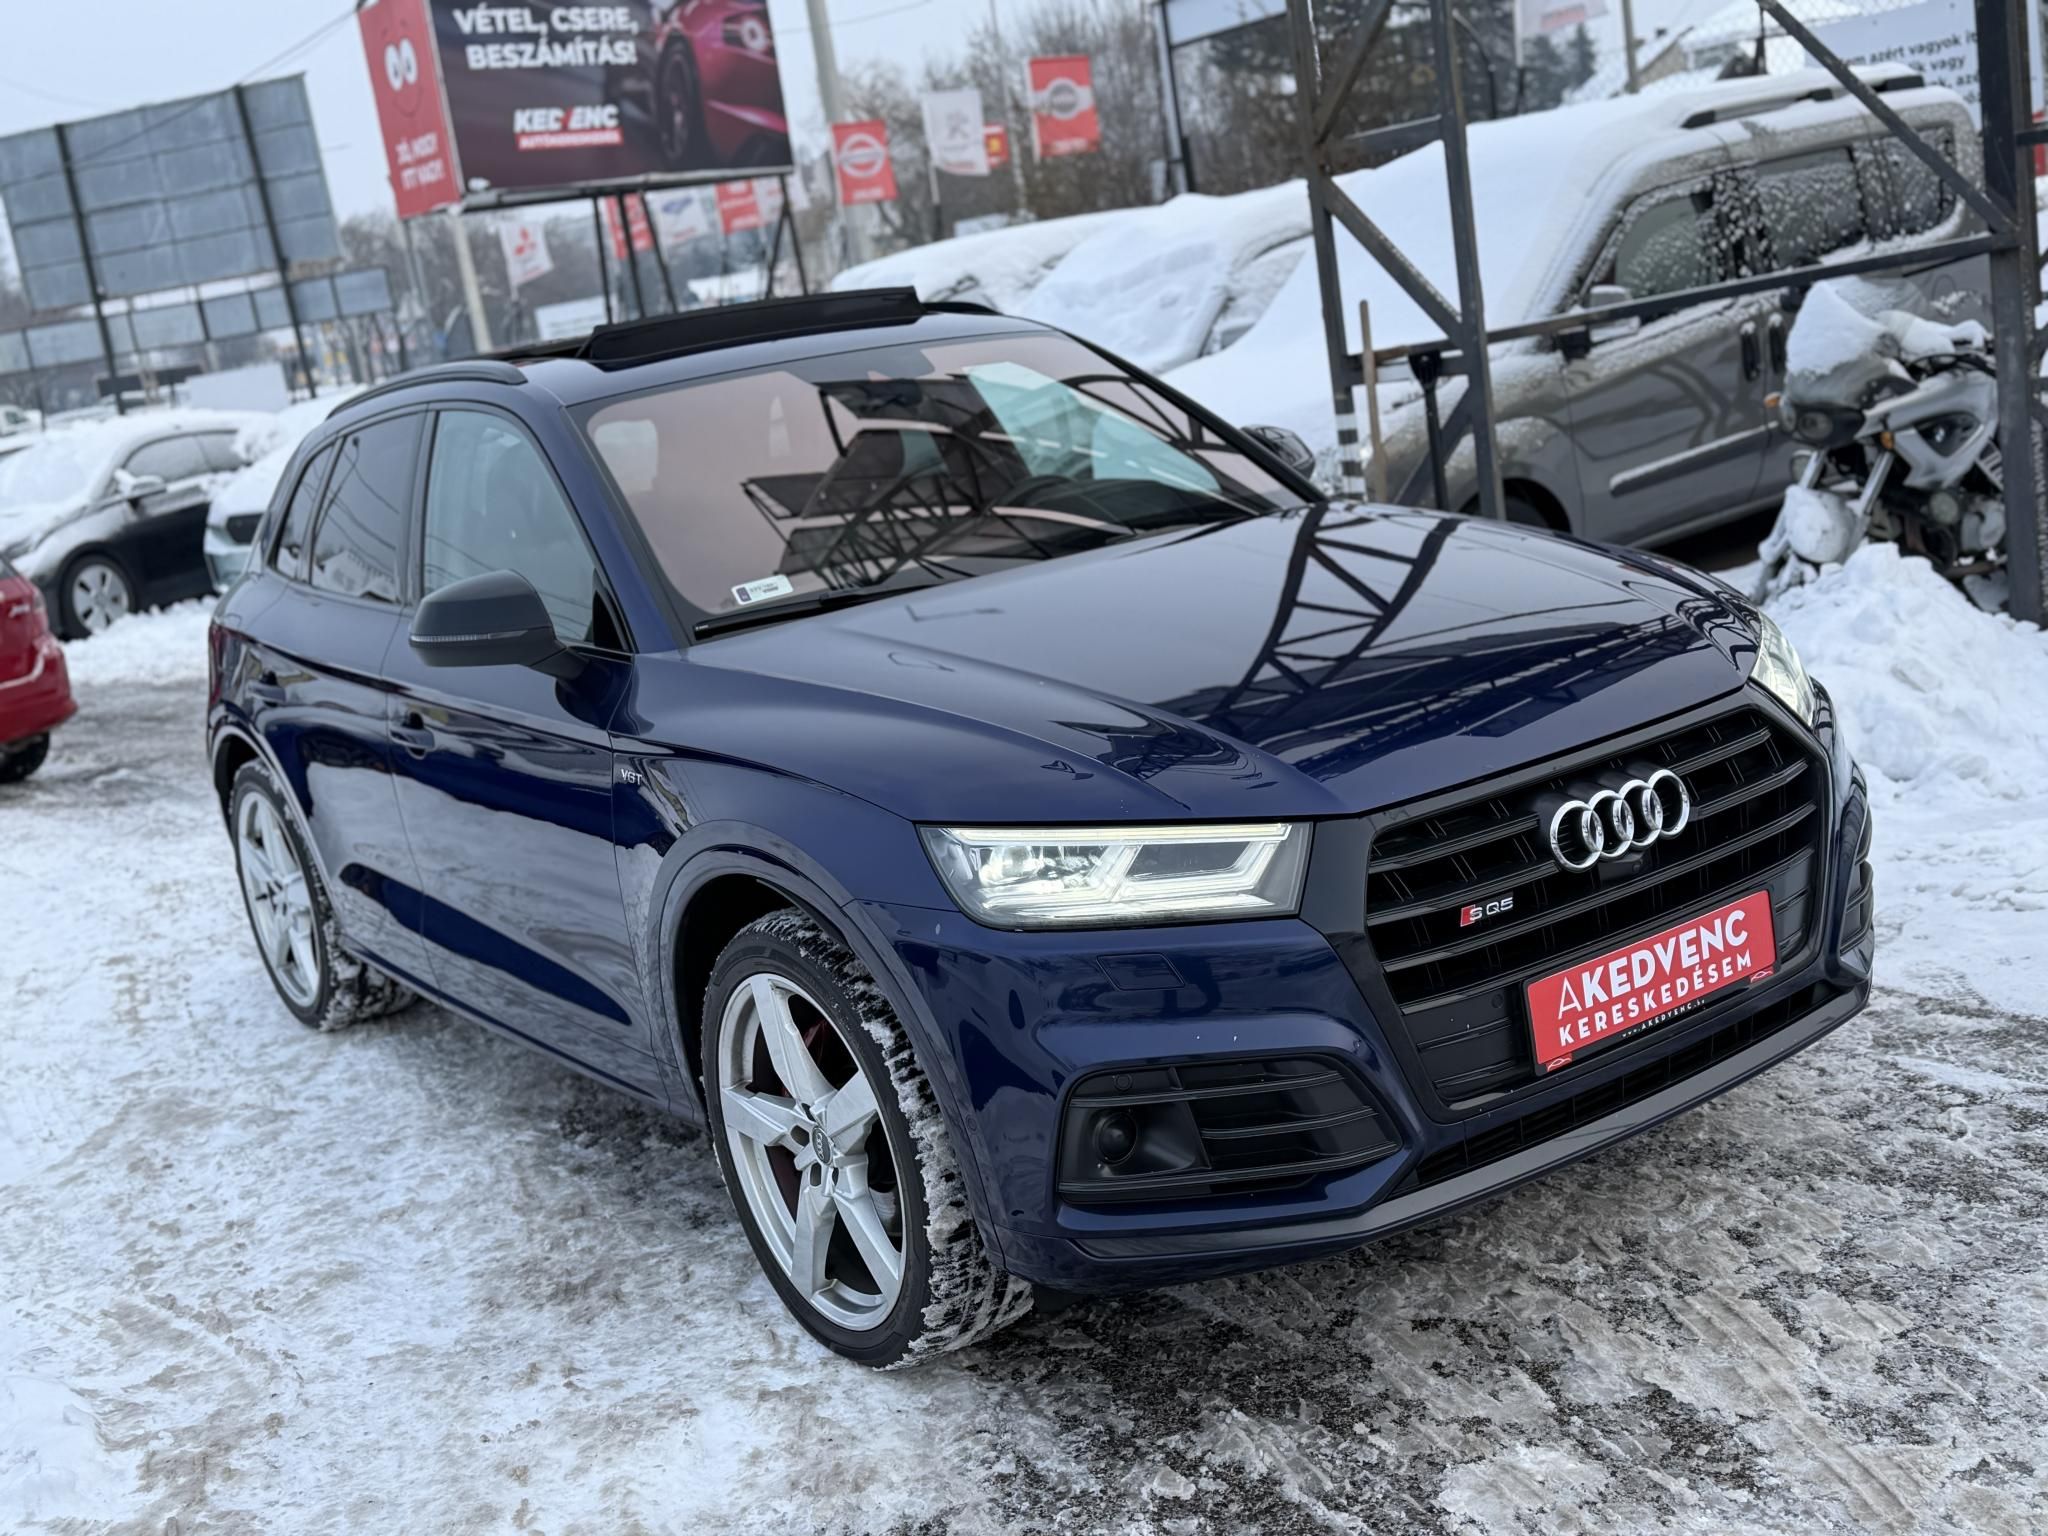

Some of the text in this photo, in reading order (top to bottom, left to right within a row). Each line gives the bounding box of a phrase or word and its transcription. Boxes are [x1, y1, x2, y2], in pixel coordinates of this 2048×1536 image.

[453, 3, 639, 36] VÉTEL, CSERE,
[465, 36, 638, 70] BESZÁMÍTÁS!
[1871, 46, 1904, 63] azért
[1908, 34, 1961, 56] vagyok
[1930, 56, 1966, 71] vagy
[1469, 896, 1514, 921] SQ5
[1558, 948, 1752, 1047] KERESKEDÉSEM
